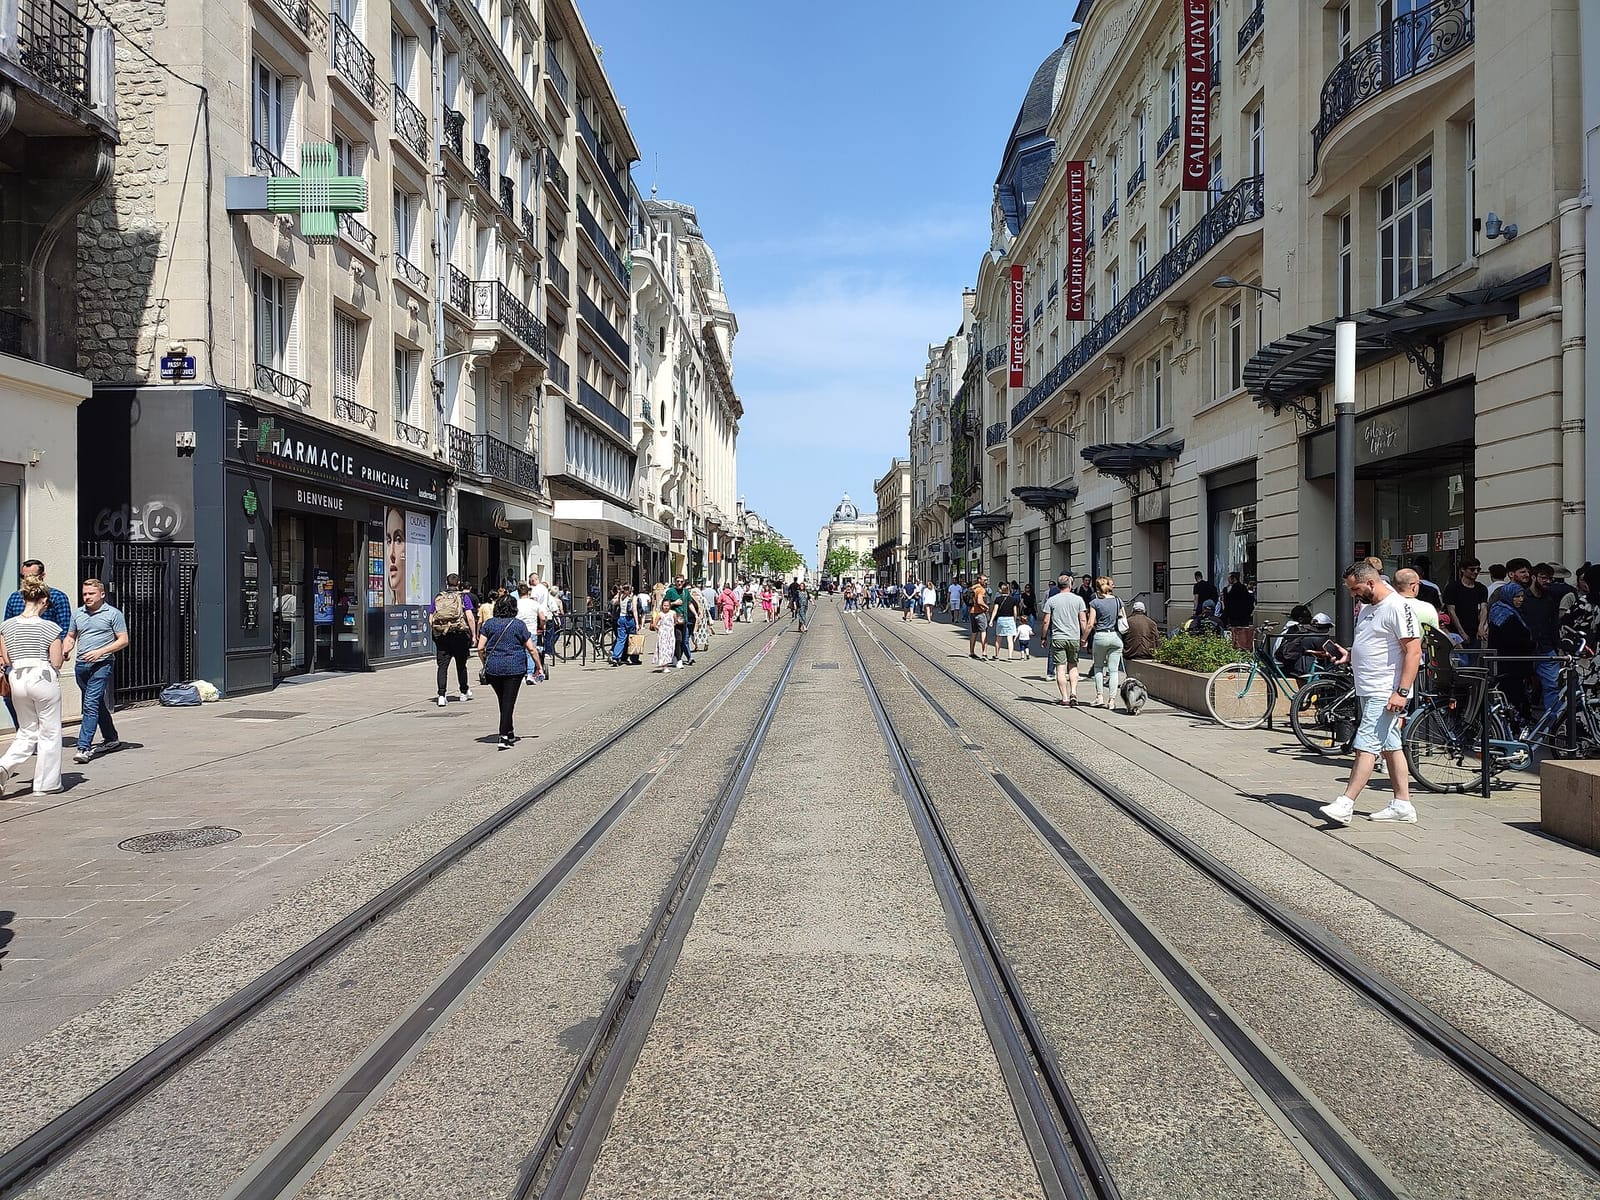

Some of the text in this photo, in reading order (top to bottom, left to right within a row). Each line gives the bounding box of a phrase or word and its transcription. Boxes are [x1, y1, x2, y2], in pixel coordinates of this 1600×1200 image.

[1189, 0, 1206, 178] GALERIES LAFAYE
[1070, 169, 1083, 312] GALERIES LAFAYETTE
[1011, 280, 1023, 372] Furet du nord
[271, 437, 409, 490] HARMACIE PRINCIPALE
[297, 489, 344, 511] BIENVENUE
